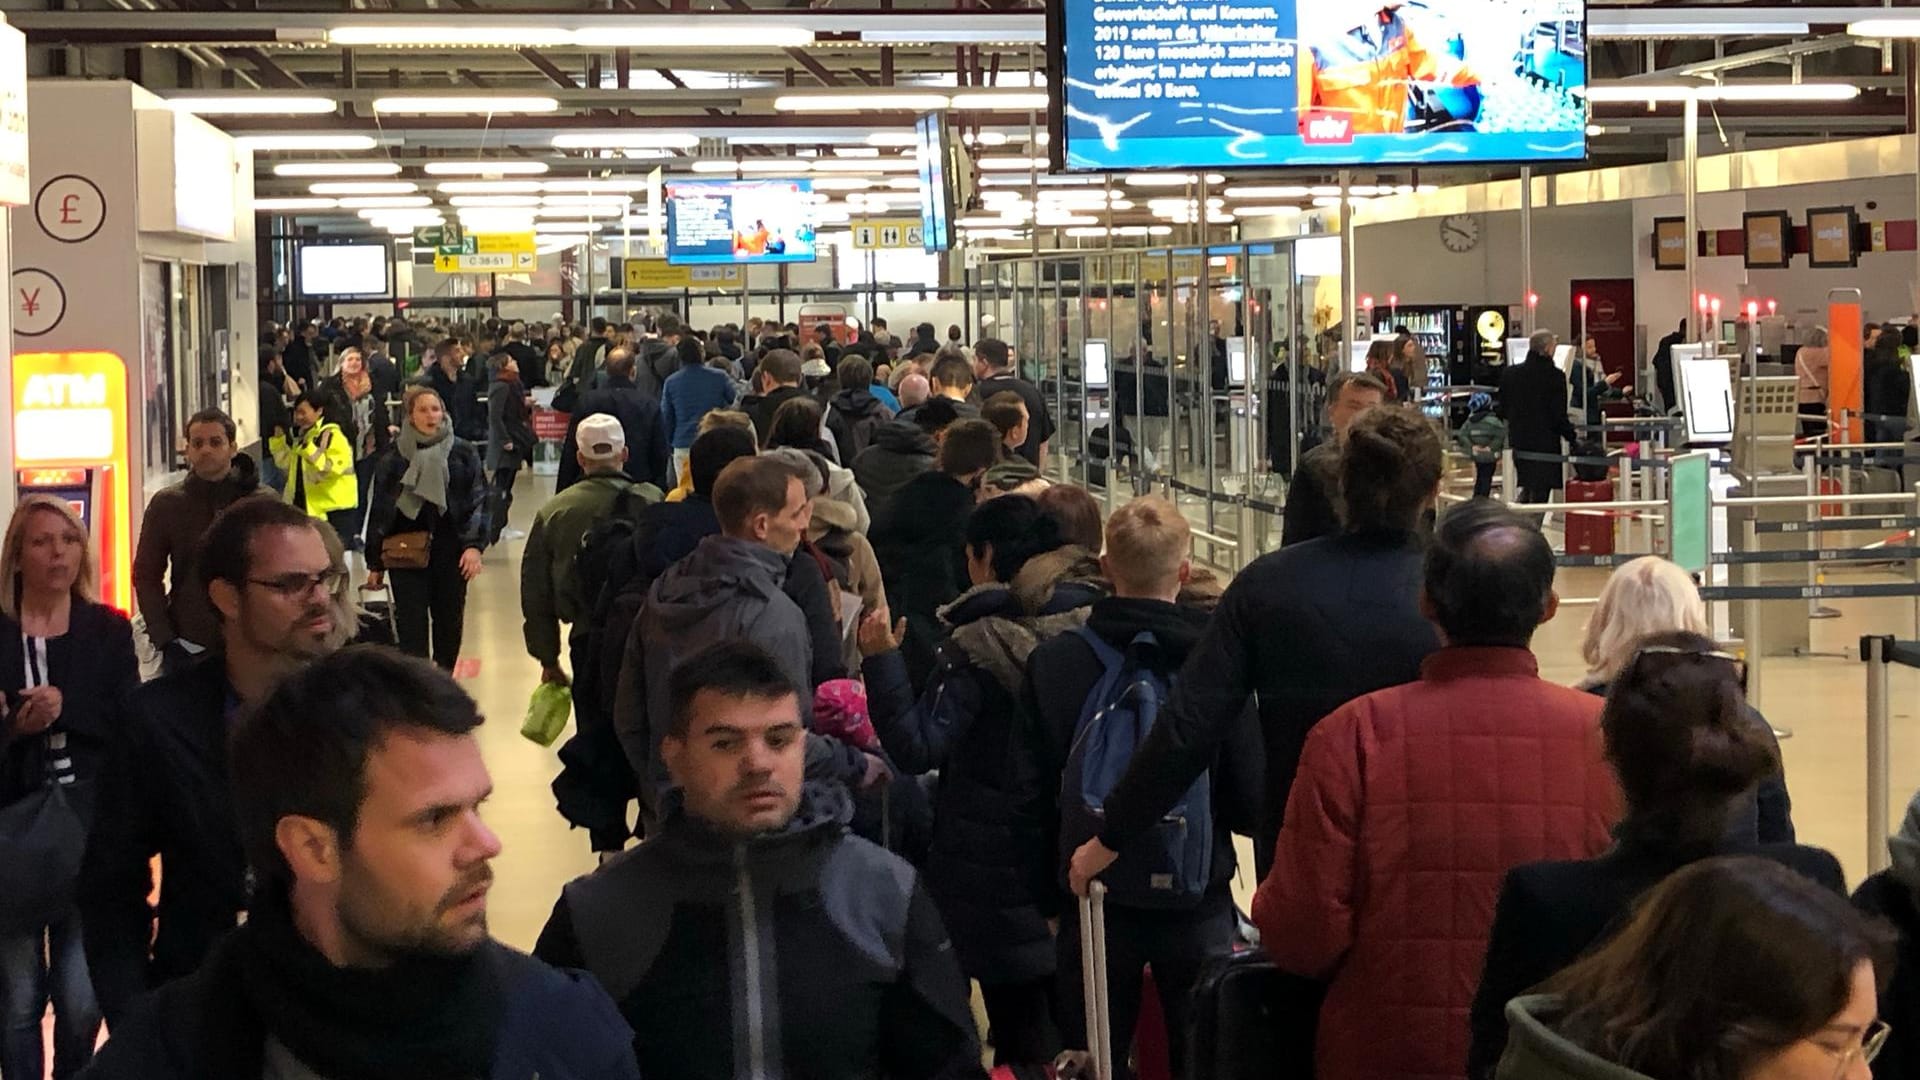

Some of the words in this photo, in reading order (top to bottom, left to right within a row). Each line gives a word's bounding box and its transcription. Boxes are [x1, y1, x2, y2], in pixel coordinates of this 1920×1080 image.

[1094, 5, 1188, 21] Gewerkschaft
[1190, 5, 1217, 20] und
[1094, 26, 1129, 41] 2019
[1131, 24, 1173, 40] sollen
[1175, 24, 1197, 40] die
[1095, 45, 1120, 60] 120
[1123, 45, 1155, 60] Euro
[1158, 43, 1226, 59] monatlich
[1159, 63, 1177, 78] im
[1179, 62, 1207, 78] Jahr
[1210, 61, 1255, 78] darauf
[1258, 61, 1291, 77] noch
[1144, 83, 1162, 98] 90
[1165, 82, 1199, 98] Euro.
[59, 194, 82, 224] £
[20, 287, 41, 316] ¥
[23, 373, 106, 406] ATM
[1802, 587, 1823, 597] BER
